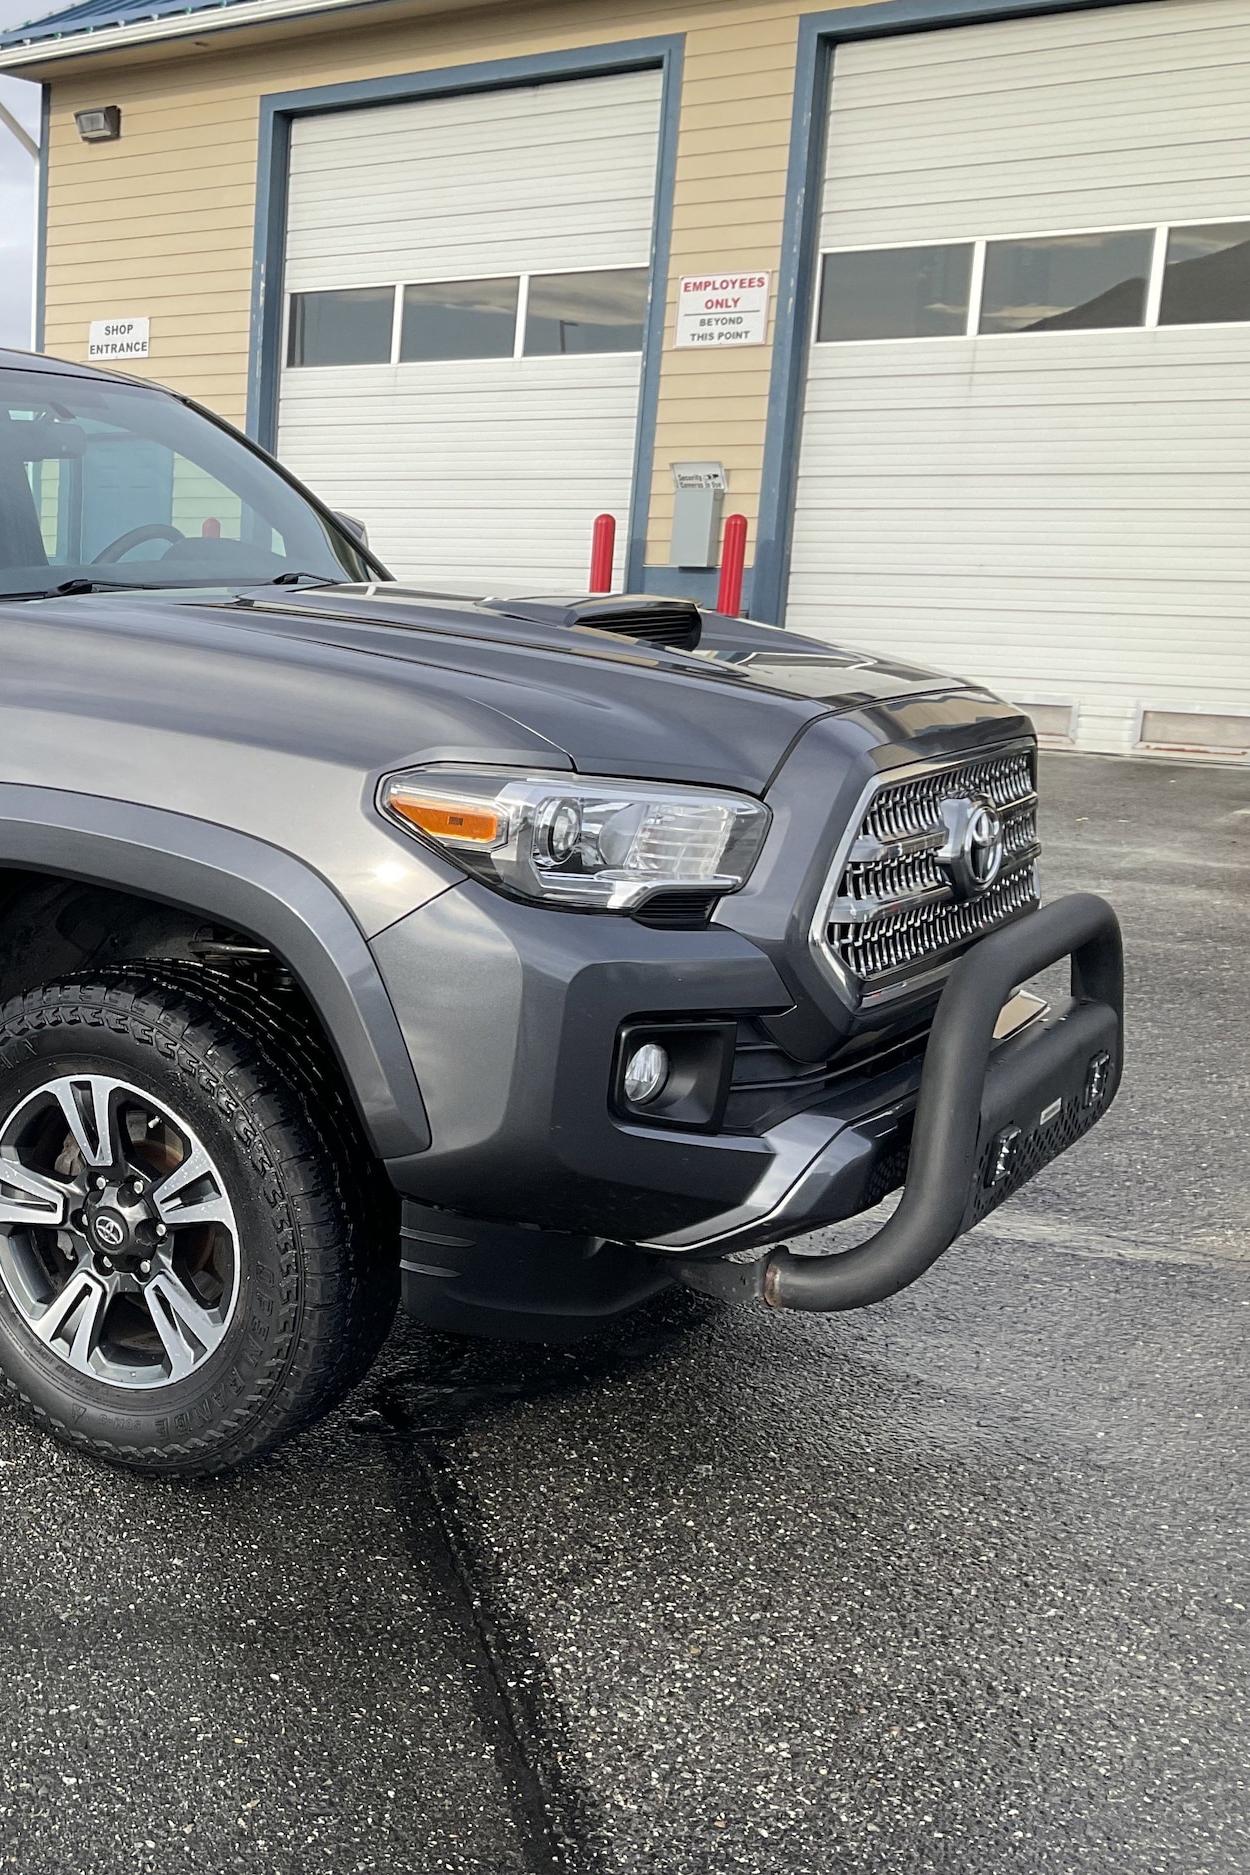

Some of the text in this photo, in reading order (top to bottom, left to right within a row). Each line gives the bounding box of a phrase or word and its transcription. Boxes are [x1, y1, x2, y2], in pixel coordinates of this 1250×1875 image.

[683, 277, 765, 292] EMPLOYEES
[704, 297, 741, 309] ONLY
[699, 316, 743, 327] BEYOND
[104, 324, 134, 336] SHOP
[690, 330, 750, 341] THIS POINT
[90, 341, 148, 355] ENTRANCE
[678, 474, 702, 482] Security
[154, 1263, 275, 1440] OPEN RANGE
